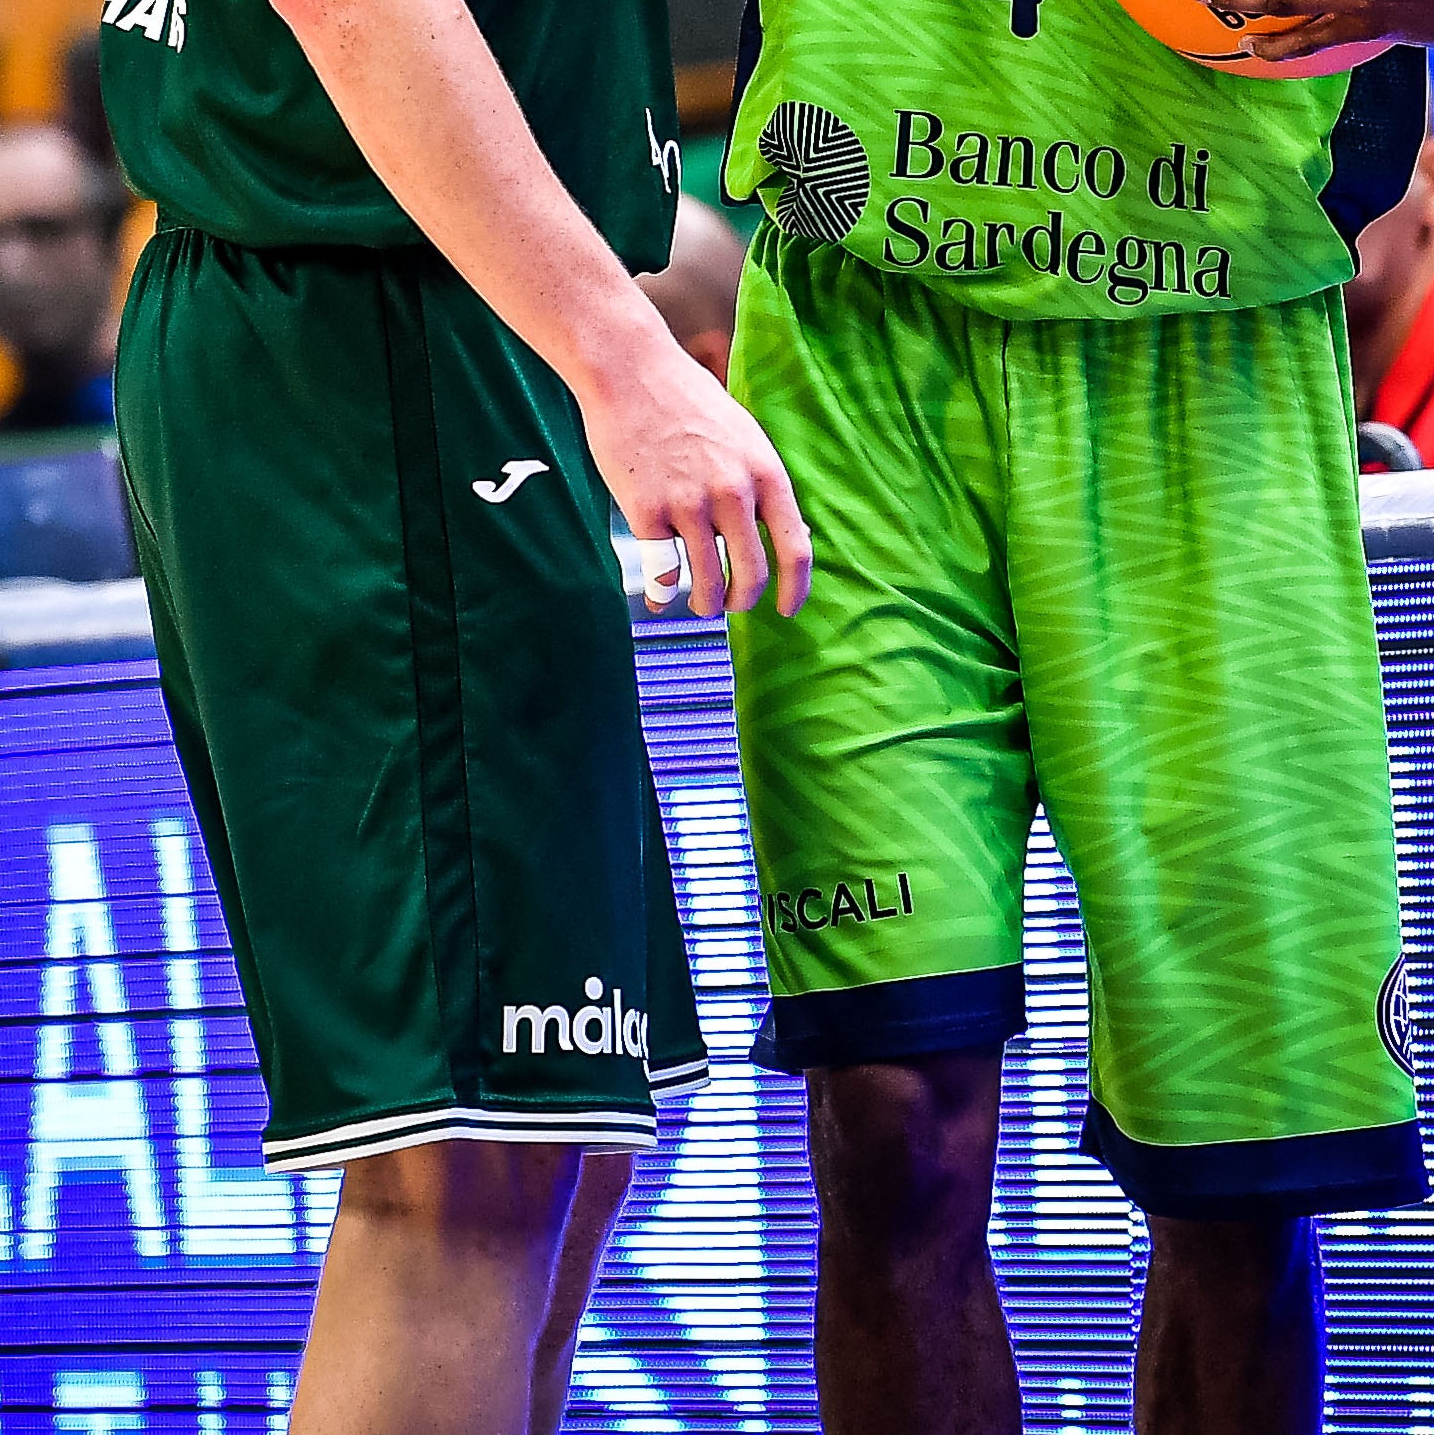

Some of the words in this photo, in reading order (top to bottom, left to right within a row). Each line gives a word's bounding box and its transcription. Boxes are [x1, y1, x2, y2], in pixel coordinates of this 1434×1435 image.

[889, 109, 1127, 199] Banco
[1146, 142, 1211, 213] di
[882, 196, 1232, 307] Sardegna
[761, 873, 913, 936] ISCALI
[502, 975, 650, 1061] mála
